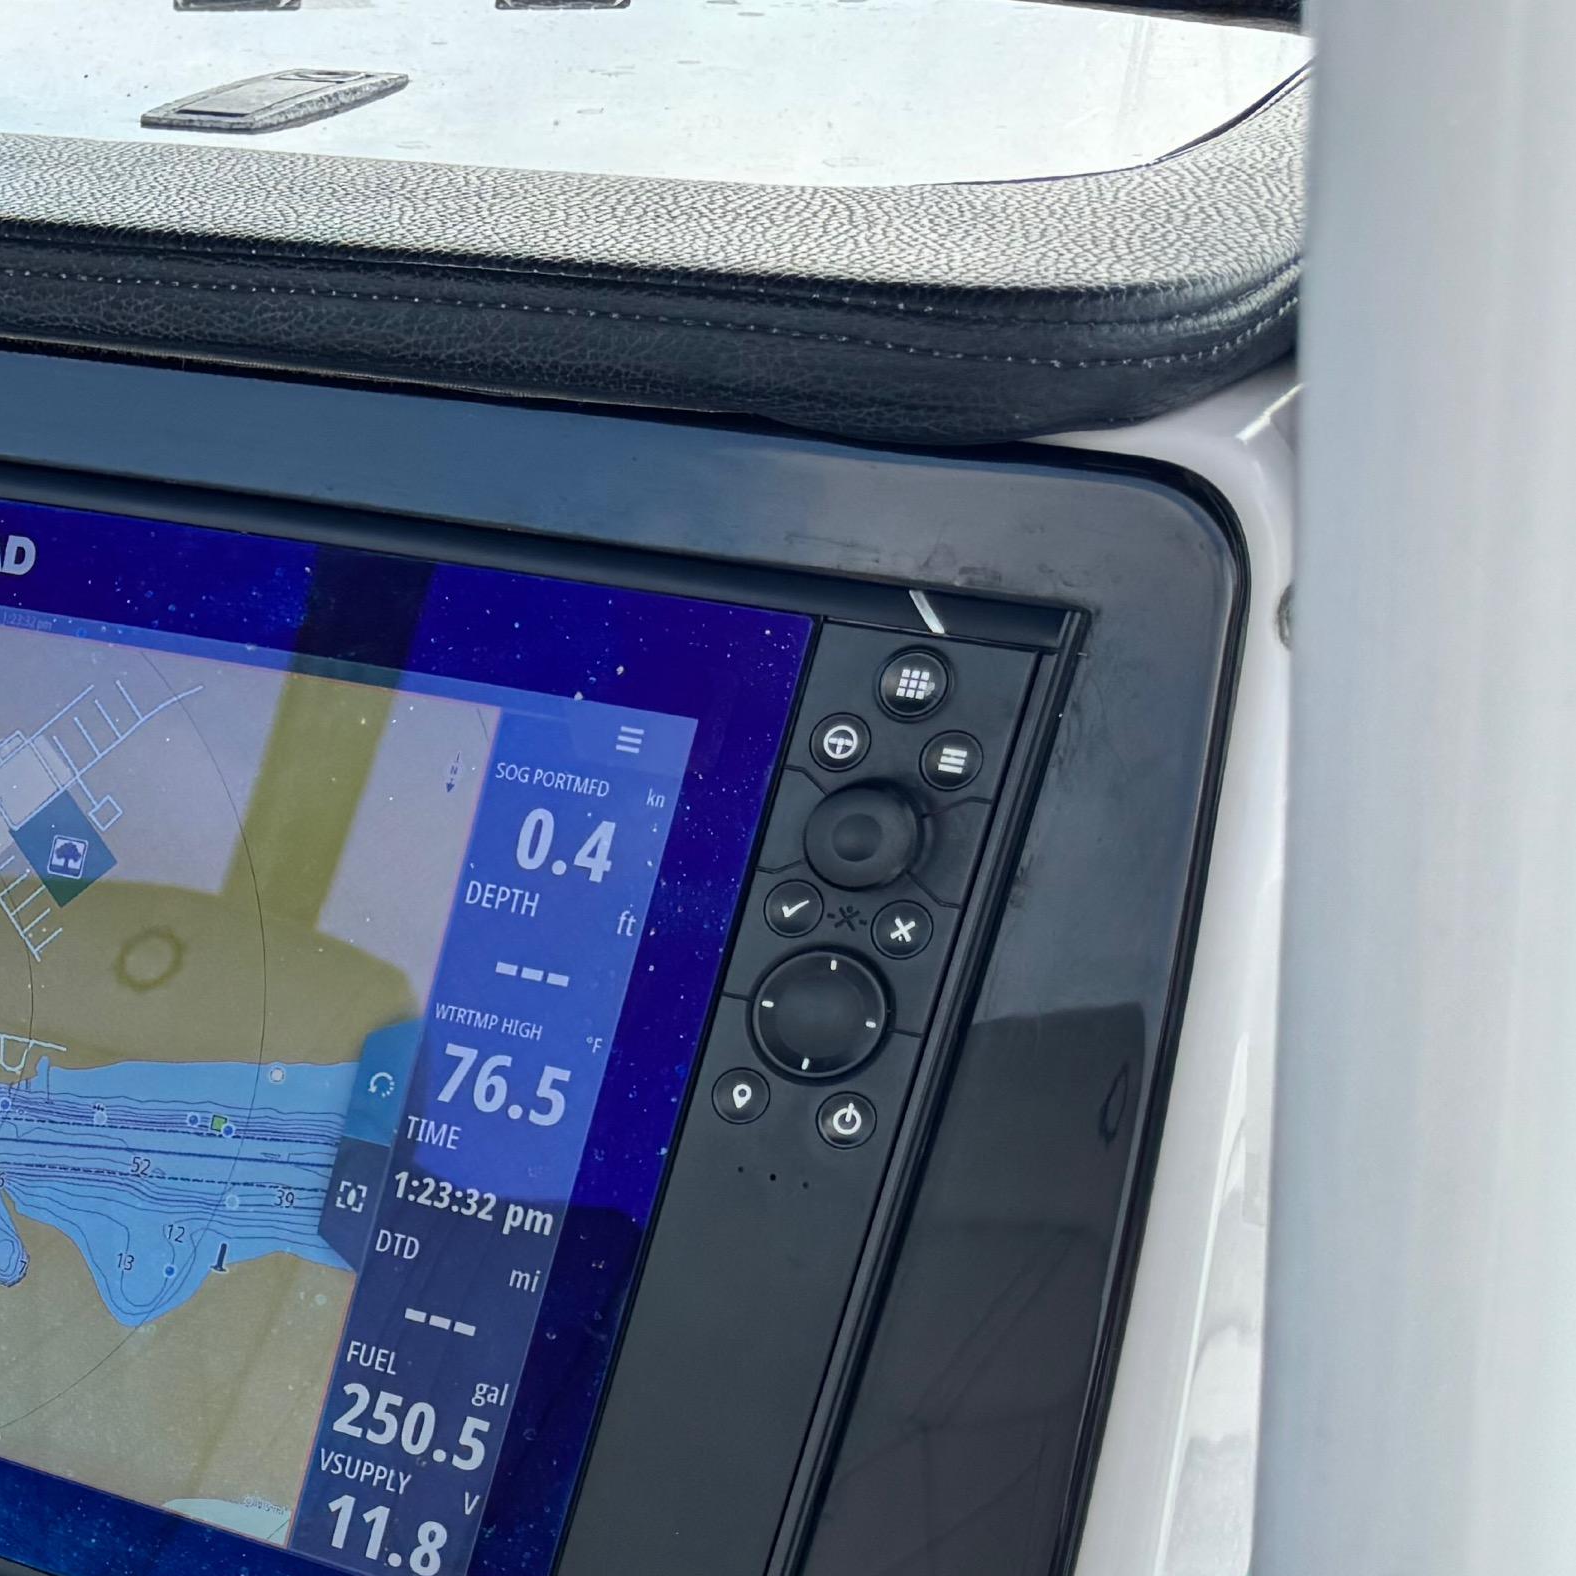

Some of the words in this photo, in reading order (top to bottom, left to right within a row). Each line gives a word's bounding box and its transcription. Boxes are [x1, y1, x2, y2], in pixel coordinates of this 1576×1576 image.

[495, 762, 530, 784] SOG
[533, 769, 609, 797] PORTMFD
[646, 788, 665, 808] kn
[516, 808, 616, 883] 0.4
[465, 880, 540, 918] DEPTH
[616, 910, 636, 936] ft
[434, 1003, 498, 1033] WTRTMP
[501, 1015, 542, 1041] HIGH
[586, 1036, 603, 1054] °F
[436, 1042, 572, 1128] 76.5
[406, 1115, 461, 1151] TIME
[131, 1157, 151, 1176] 52
[276, 1189, 296, 1208] 39
[392, 1170, 496, 1222] 1:23:32
[503, 1202, 554, 1237] pm
[117, 1253, 135, 1270] 13
[167, 1224, 186, 1243] 12
[375, 1229, 420, 1261] DTD
[509, 1265, 540, 1293] mi
[347, 1341, 397, 1376] FUEL
[471, 1380, 508, 1408] gal
[332, 1381, 491, 1472] 250.5
[321, 1448, 411, 1495] VSUPPLY
[463, 1492, 480, 1516] V
[328, 1495, 448, 1576] 11.8
